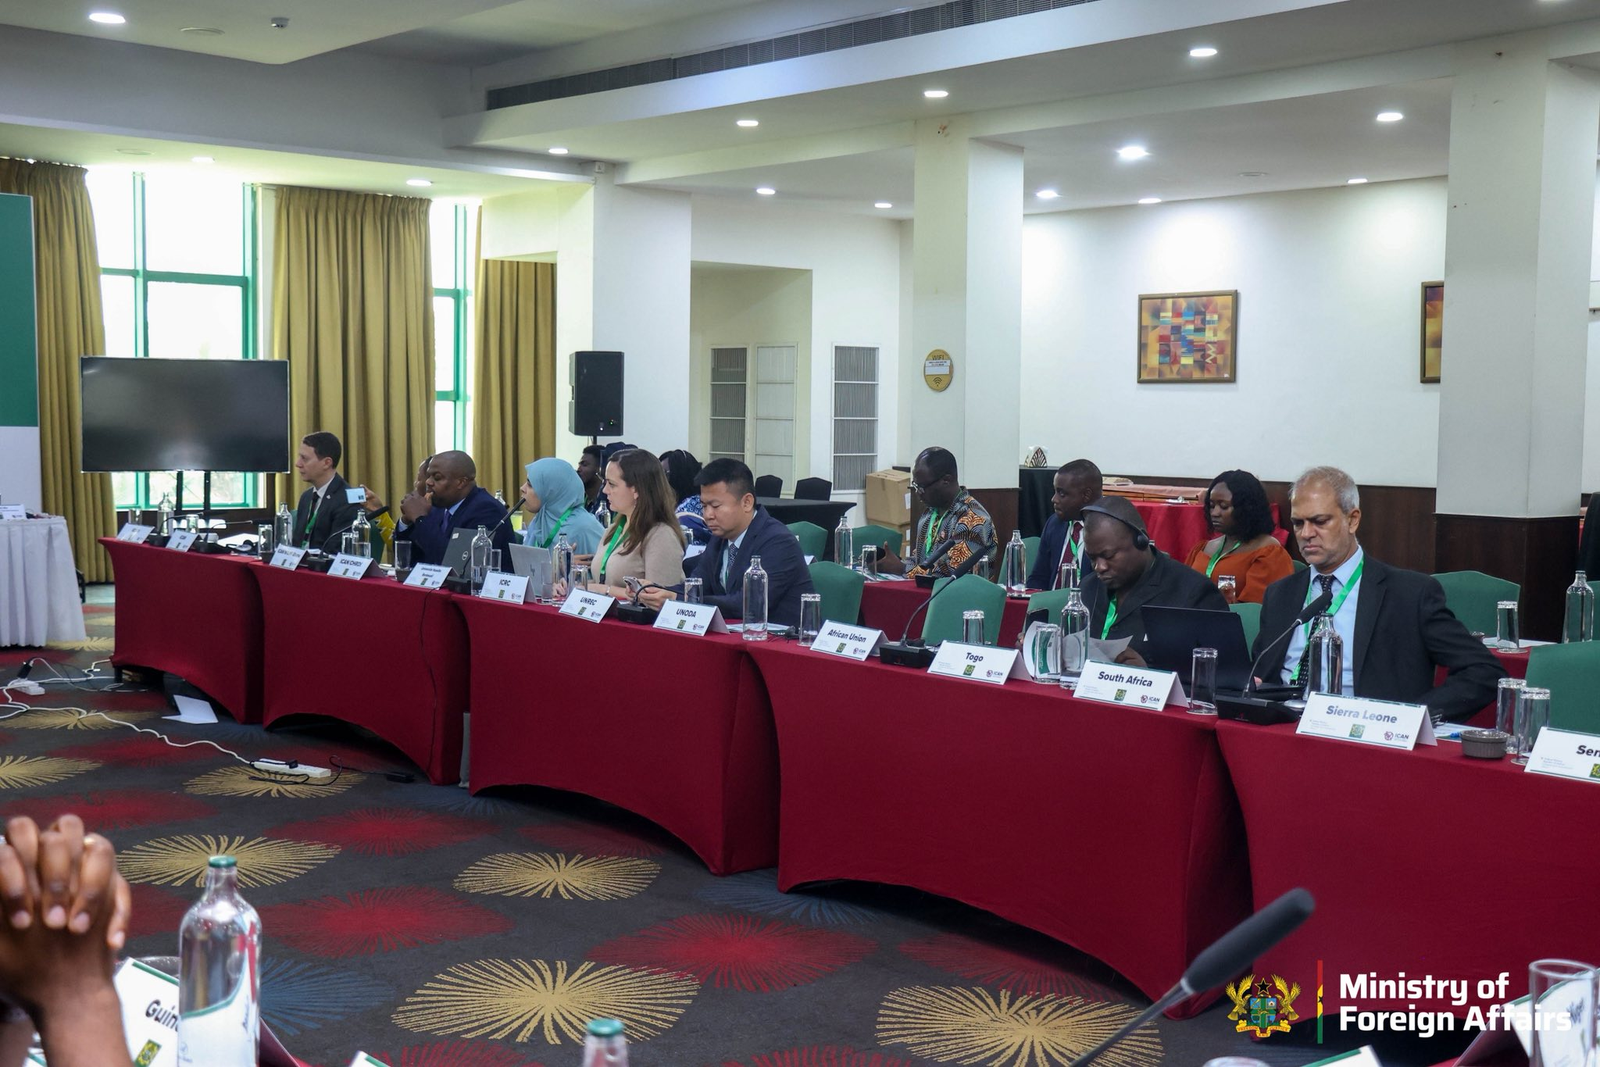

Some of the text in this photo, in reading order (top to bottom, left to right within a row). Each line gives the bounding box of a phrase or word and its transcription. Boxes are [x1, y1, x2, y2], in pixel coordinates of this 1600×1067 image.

[499, 579, 511, 587] ICRC
[580, 596, 598, 606] UNREC
[676, 608, 697, 618] UNODA
[827, 628, 867, 643] African Union
[965, 652, 984, 663] Togo
[1098, 671, 1153, 687] South Africa
[1326, 705, 1398, 724] Sierra Leone
[1394, 731, 1410, 740] ICAN
